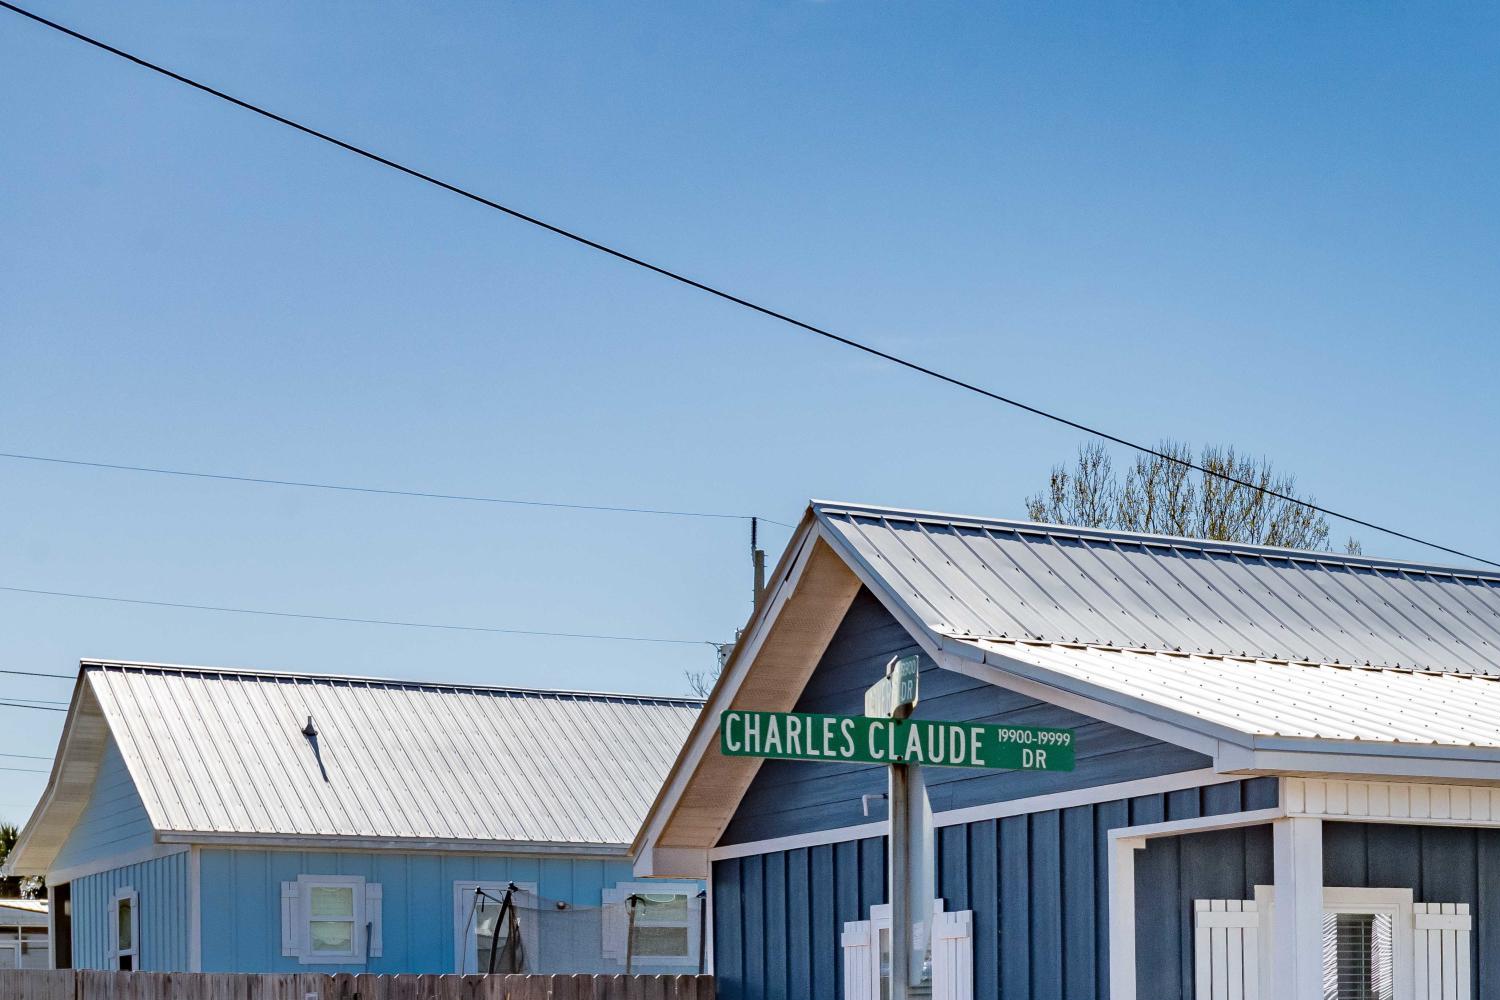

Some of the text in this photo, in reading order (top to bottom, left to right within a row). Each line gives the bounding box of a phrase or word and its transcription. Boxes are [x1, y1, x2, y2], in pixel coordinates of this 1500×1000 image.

[724, 713, 986, 766] CHARLES CLAUDE
[997, 728, 1071, 747] 19900-19999
[1022, 747, 1047, 769] DR
